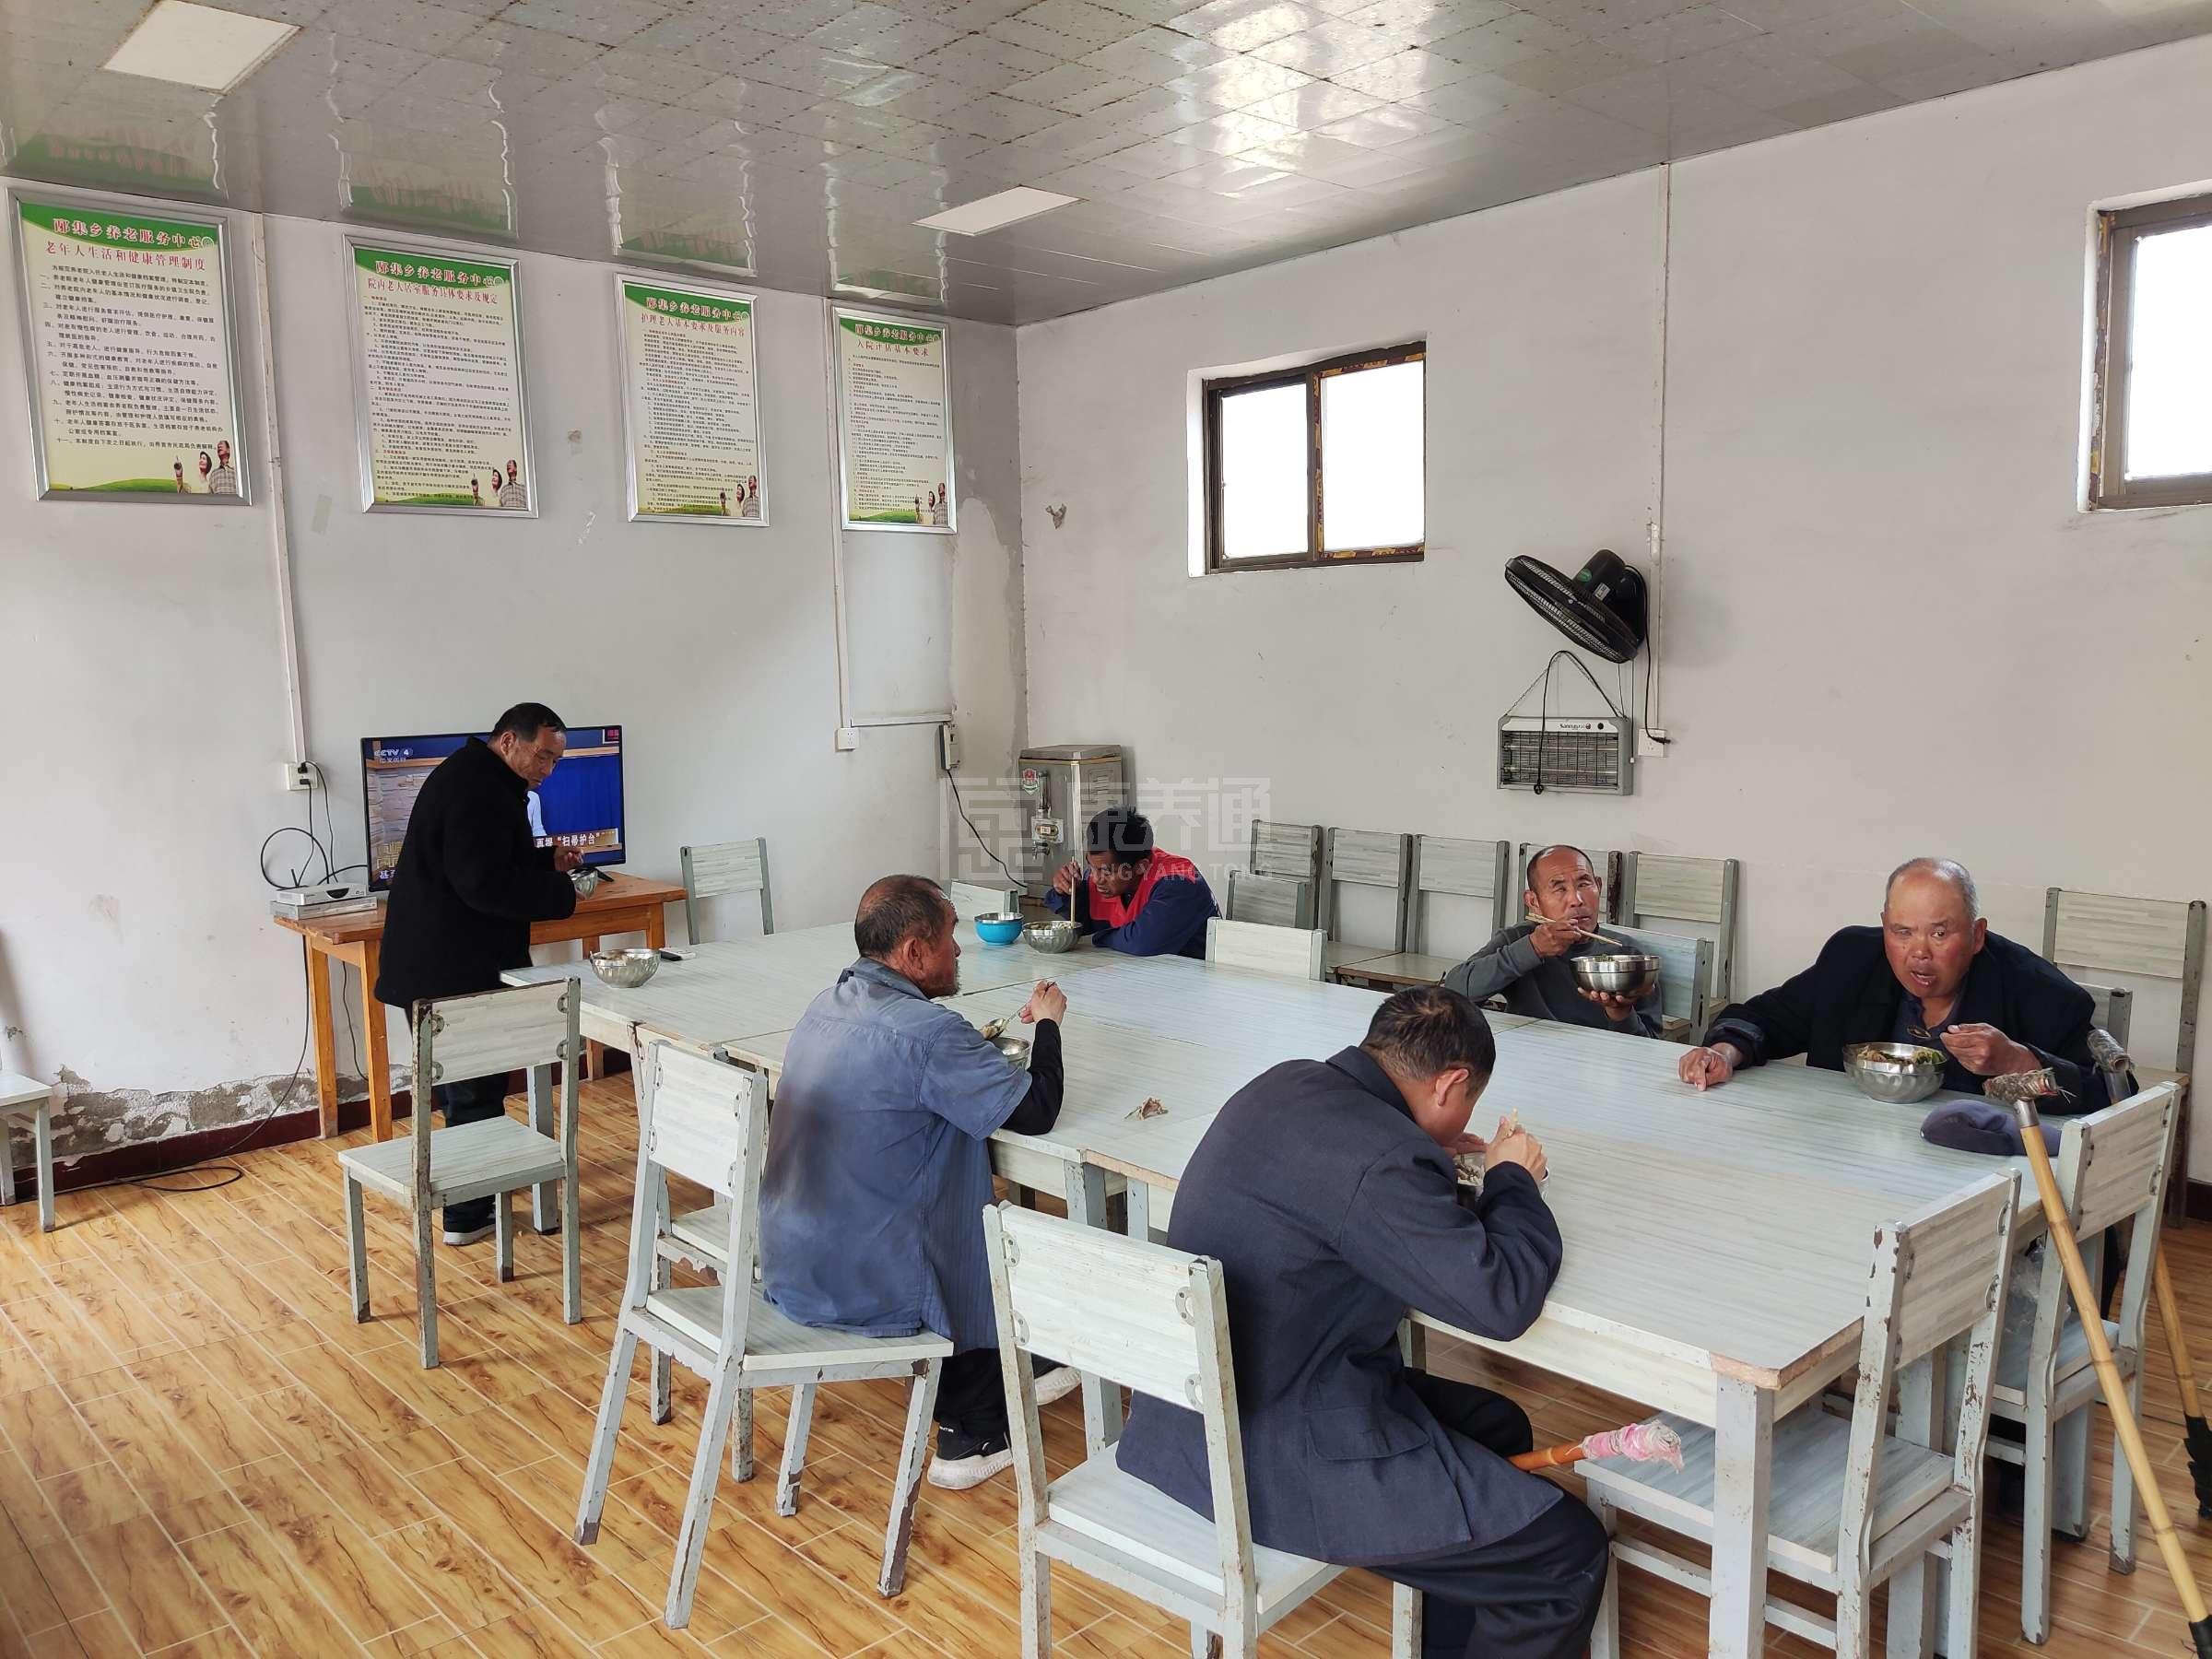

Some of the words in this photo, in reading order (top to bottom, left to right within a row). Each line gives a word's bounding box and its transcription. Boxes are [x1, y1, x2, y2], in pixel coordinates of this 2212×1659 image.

[46, 241, 206, 271] 老年人生活和健康管理制度
[374, 748, 400, 757] CCTV
